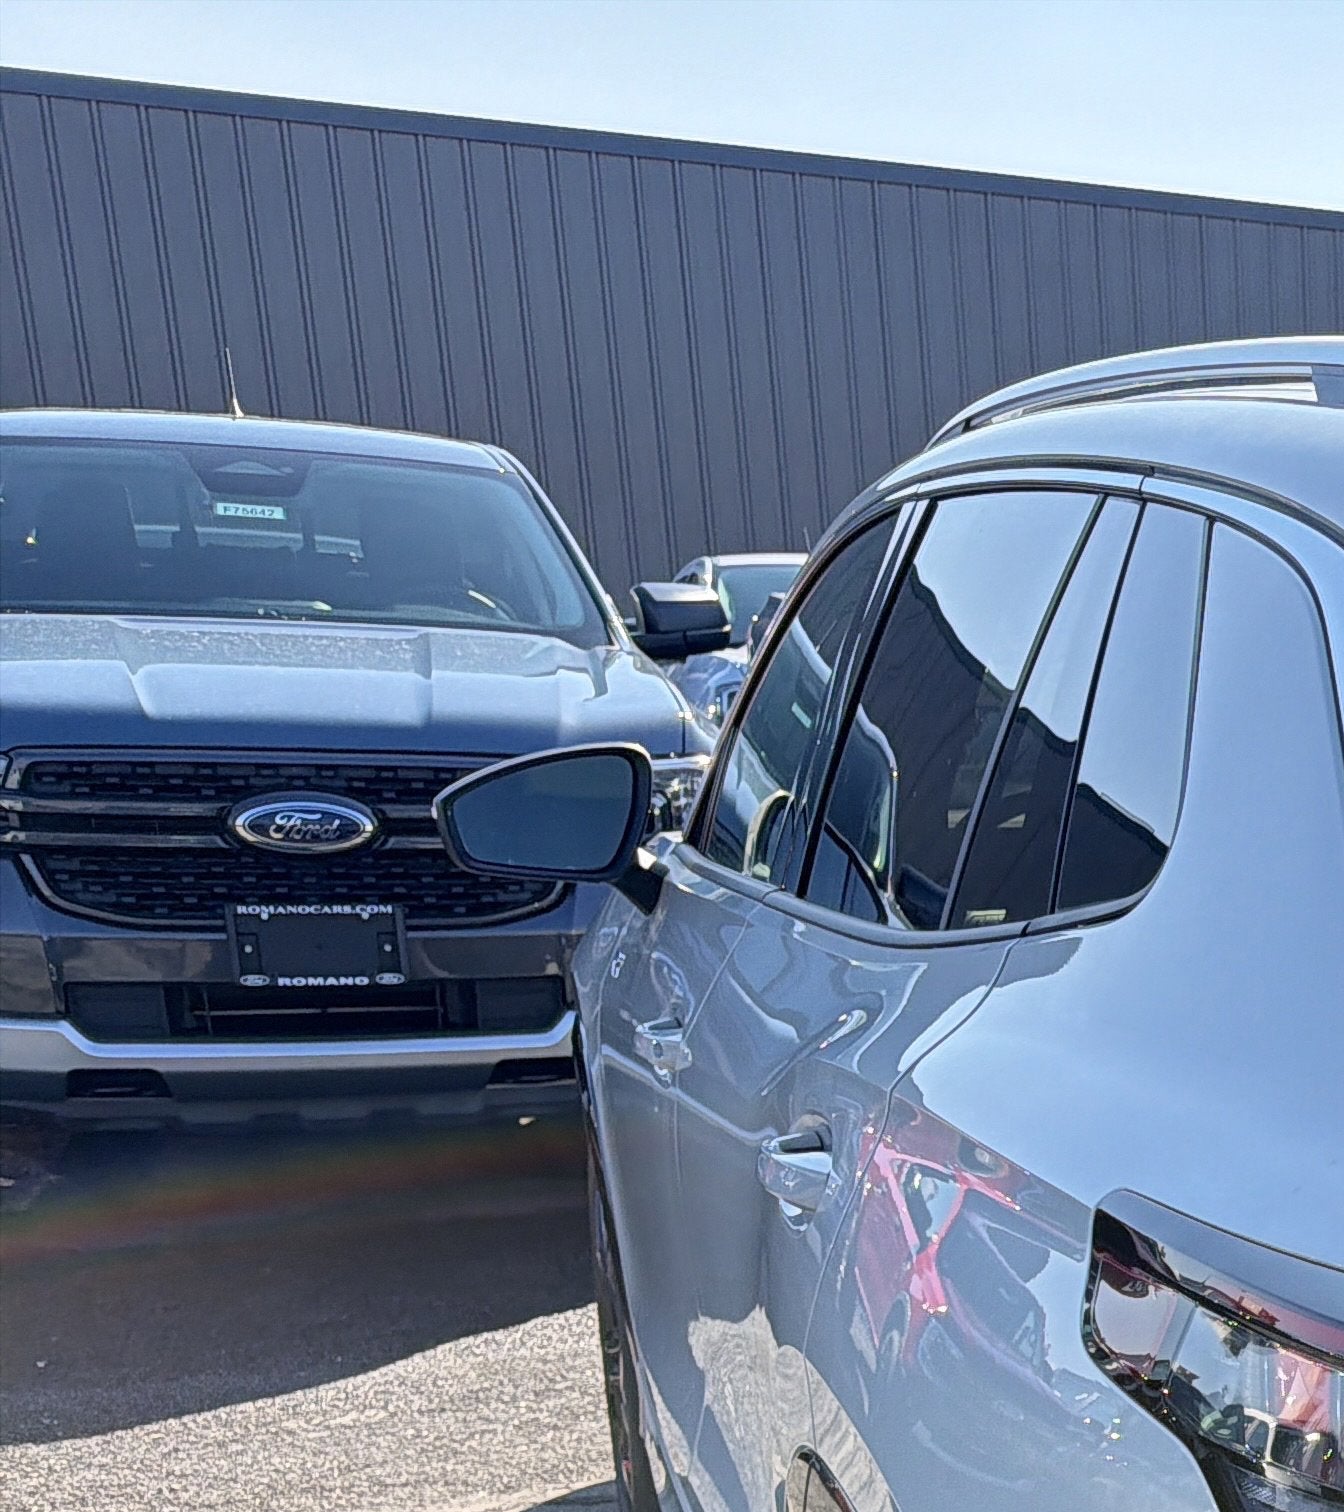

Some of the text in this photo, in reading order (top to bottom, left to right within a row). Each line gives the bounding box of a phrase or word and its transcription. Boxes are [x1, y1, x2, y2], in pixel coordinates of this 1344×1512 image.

[269, 811, 341, 840] Ford
[236, 904, 393, 915] ROMANOCARS.COM
[277, 975, 370, 987] ROMANO
